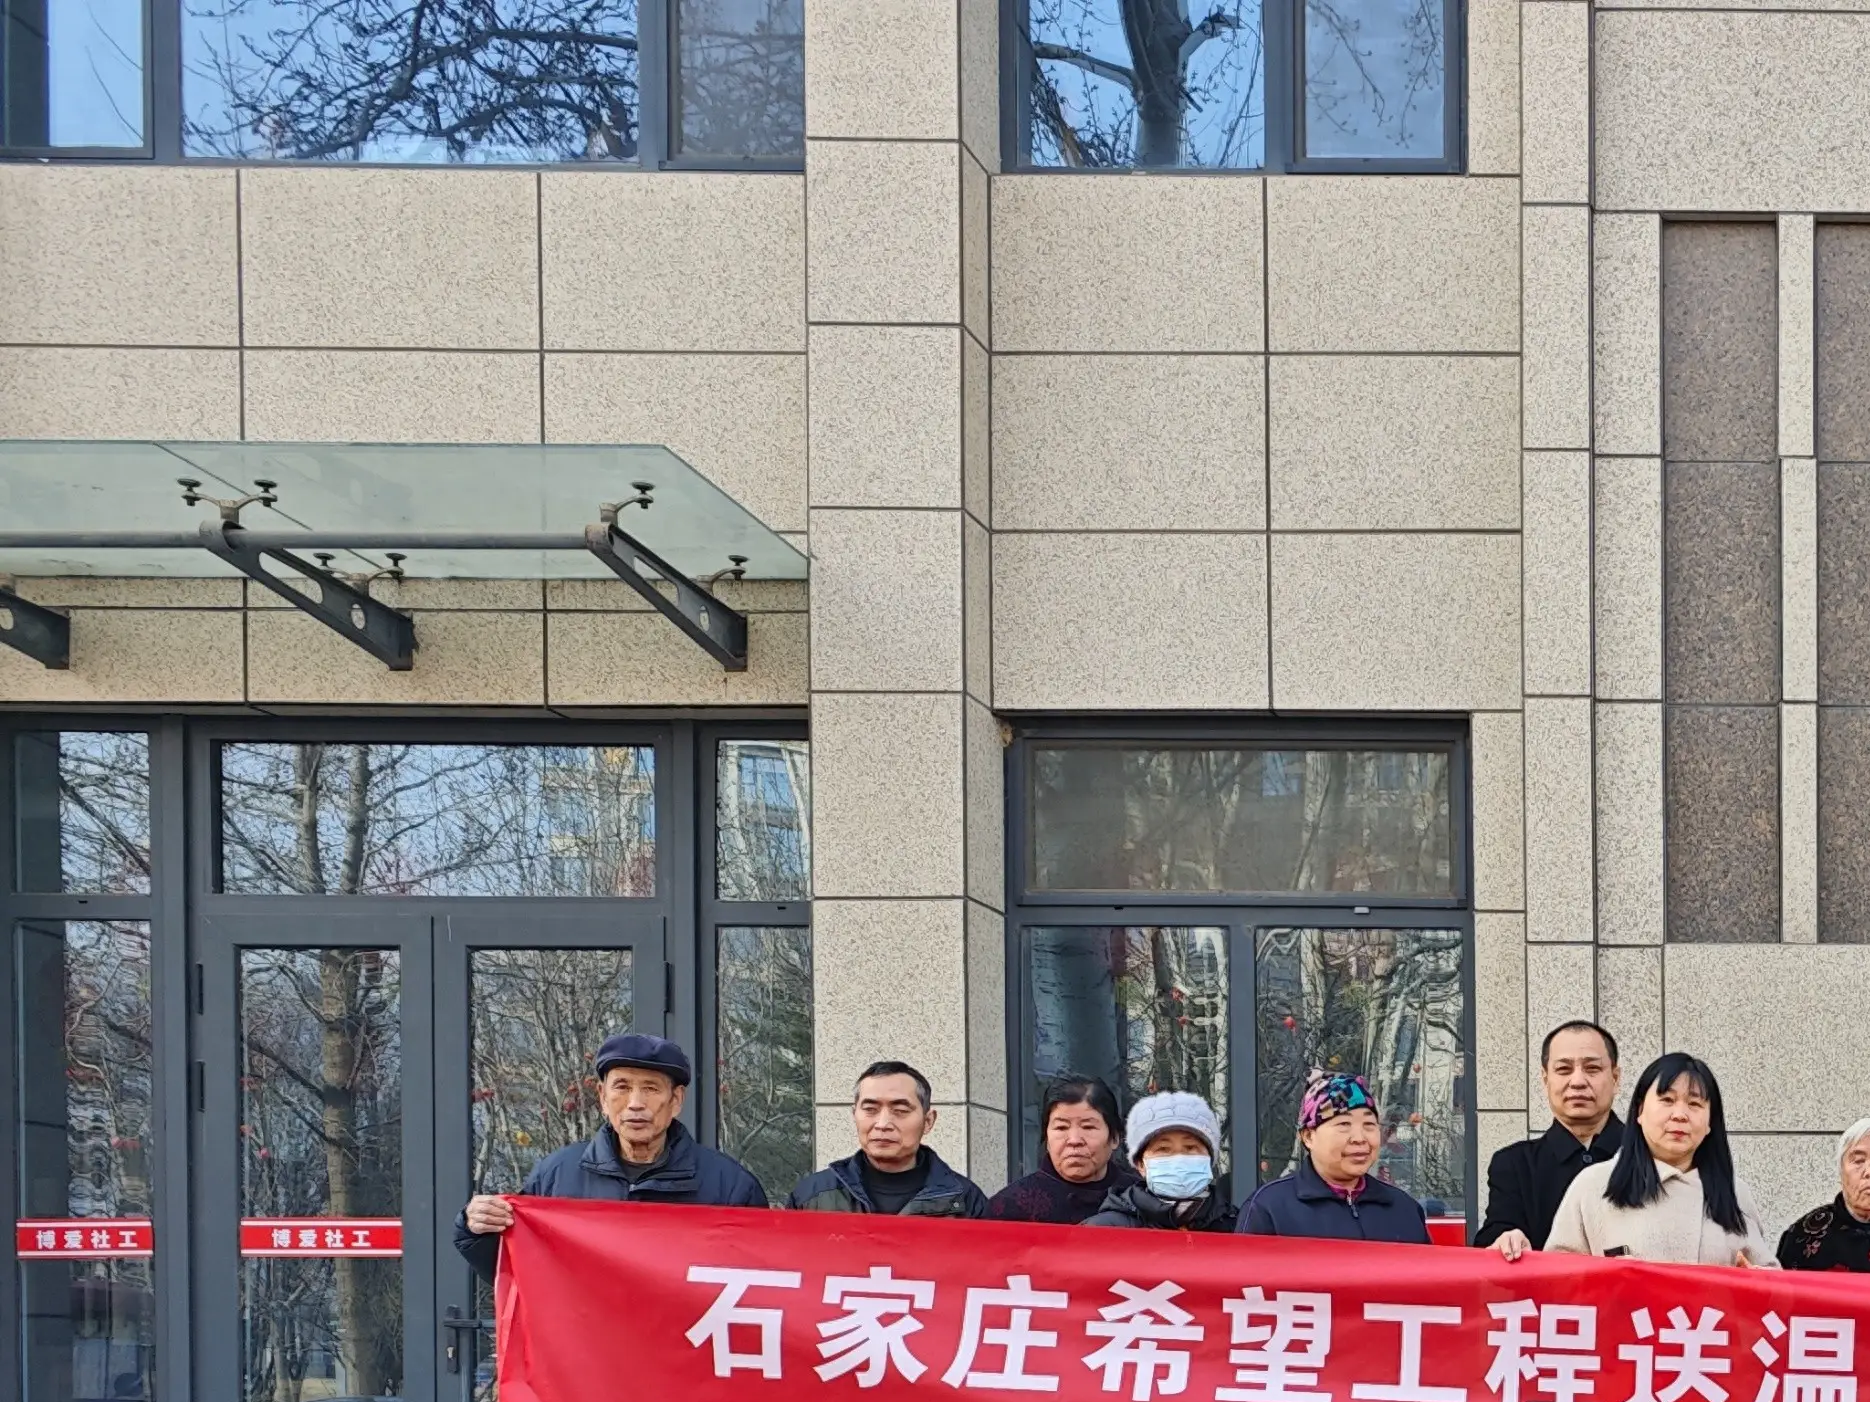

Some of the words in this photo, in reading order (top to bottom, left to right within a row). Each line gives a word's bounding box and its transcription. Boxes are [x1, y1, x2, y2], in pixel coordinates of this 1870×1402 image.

[36, 1229, 138, 1250] 博爱社工
[271, 1228, 371, 1249] 博爱社工
